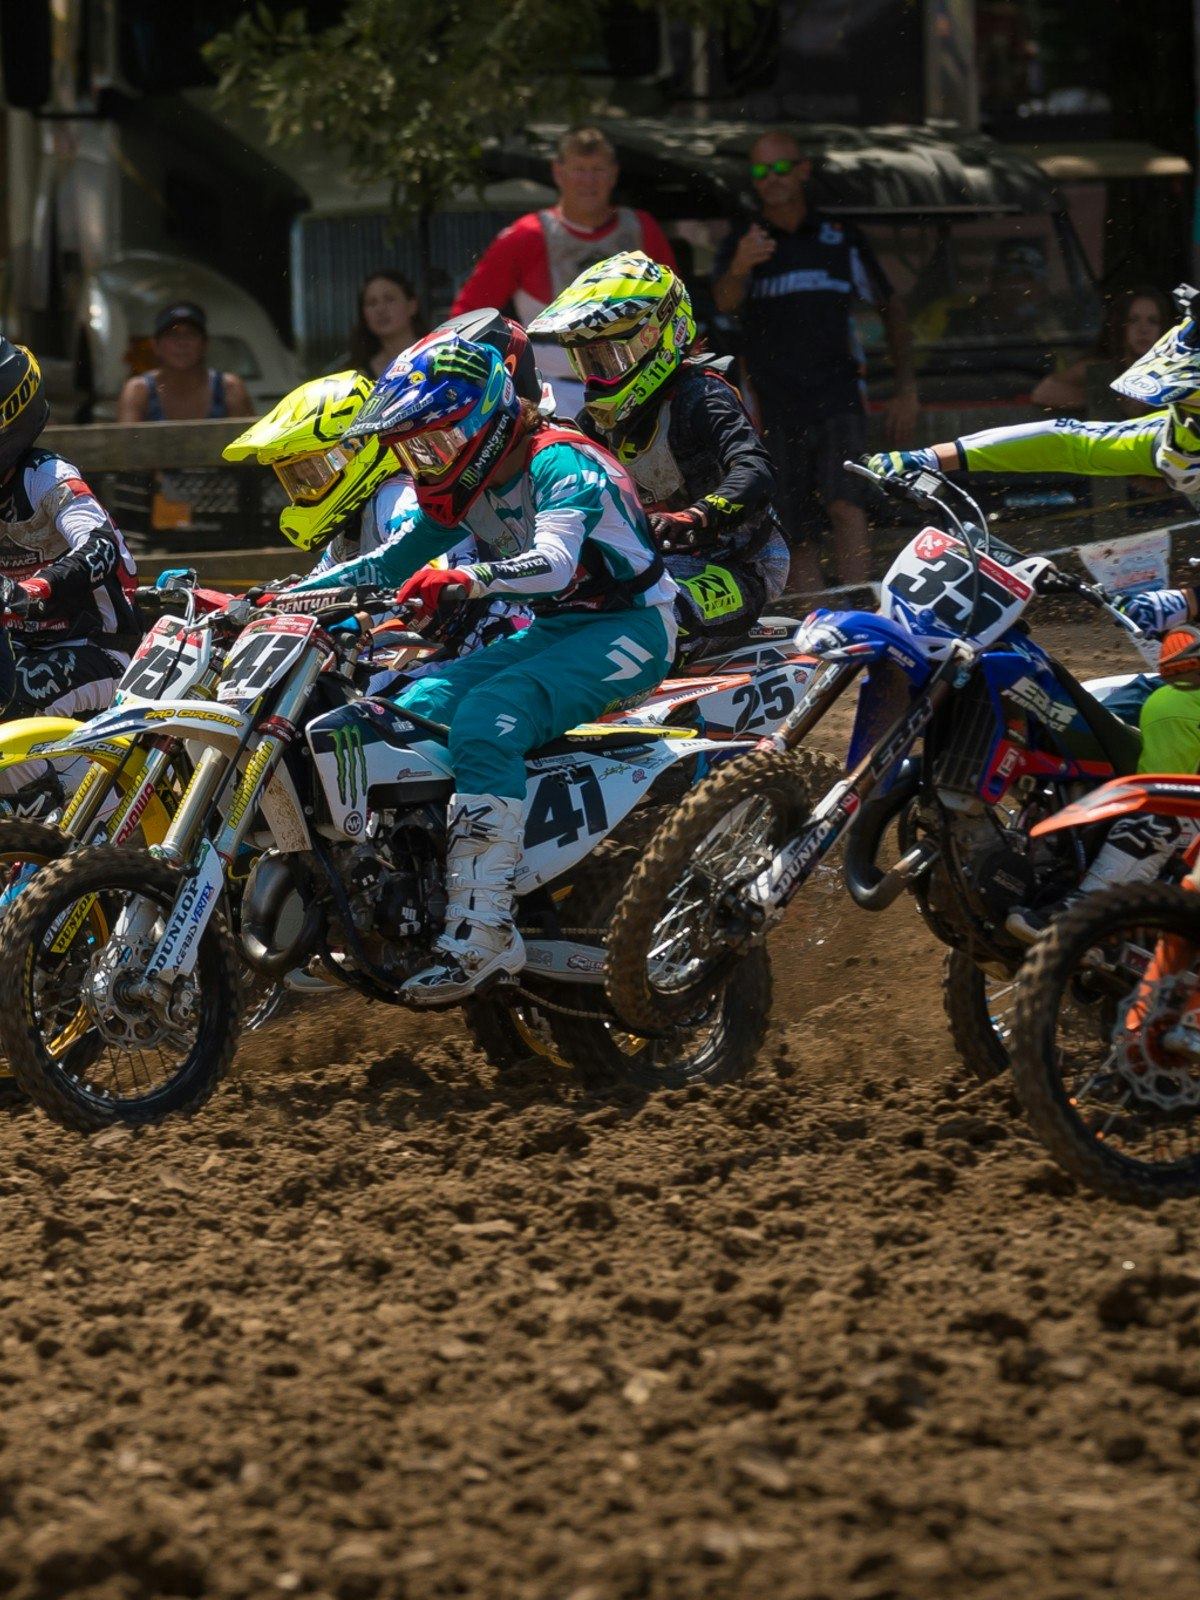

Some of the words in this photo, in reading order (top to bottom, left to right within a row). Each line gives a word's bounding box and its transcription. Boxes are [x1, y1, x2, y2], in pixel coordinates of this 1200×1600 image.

[476, 414, 510, 470] MONSTER
[495, 555, 549, 574] MONSTER
[119, 644, 197, 700] 15
[221, 634, 306, 690] 41
[144, 708, 176, 720] PRO
[176, 709, 244, 728] CIRCUIT
[731, 673, 795, 734] 25
[523, 763, 609, 850] 41
[149, 877, 200, 978] DUNLOP
[190, 880, 215, 924] VERTEX
